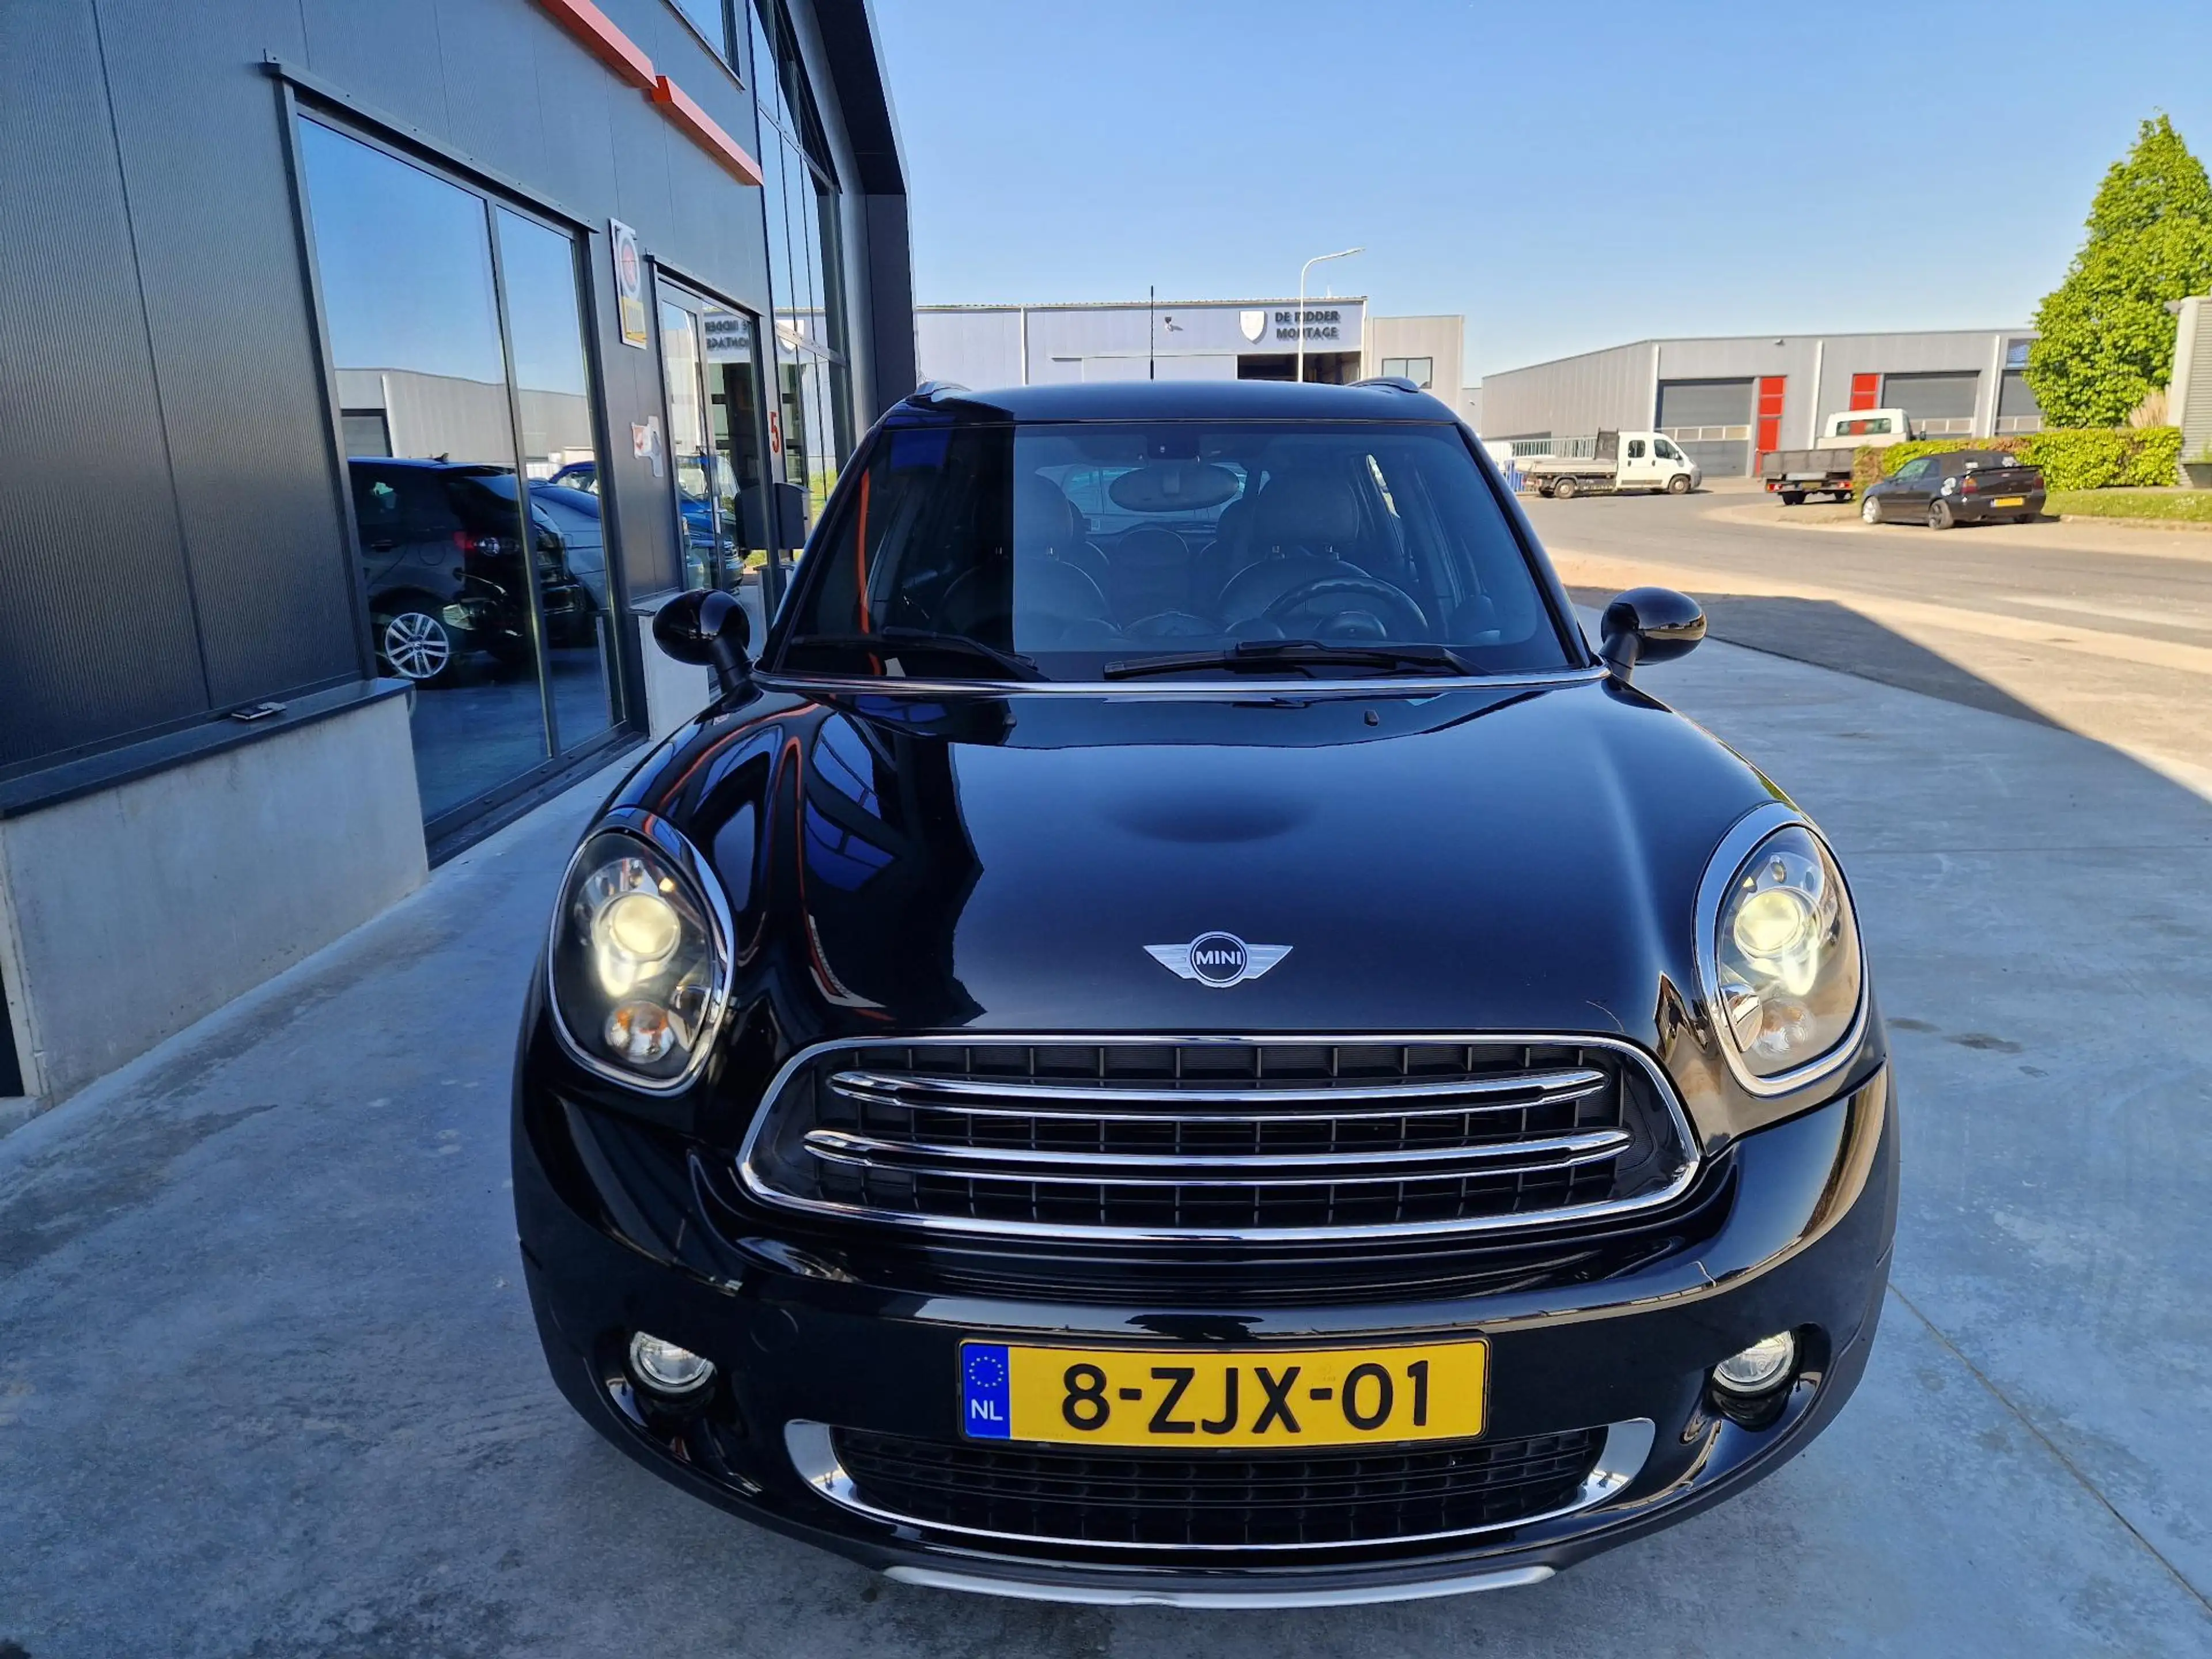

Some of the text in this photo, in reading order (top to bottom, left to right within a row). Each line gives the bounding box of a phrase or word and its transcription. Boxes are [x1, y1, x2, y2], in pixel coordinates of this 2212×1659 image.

[1275, 312, 1290, 322] DE
[771, 411, 779, 453] 5
[1196, 950, 1241, 965] MINI
[1062, 1360, 1429, 1434] 8-ZJX-01
[971, 1399, 1003, 1421] NL
